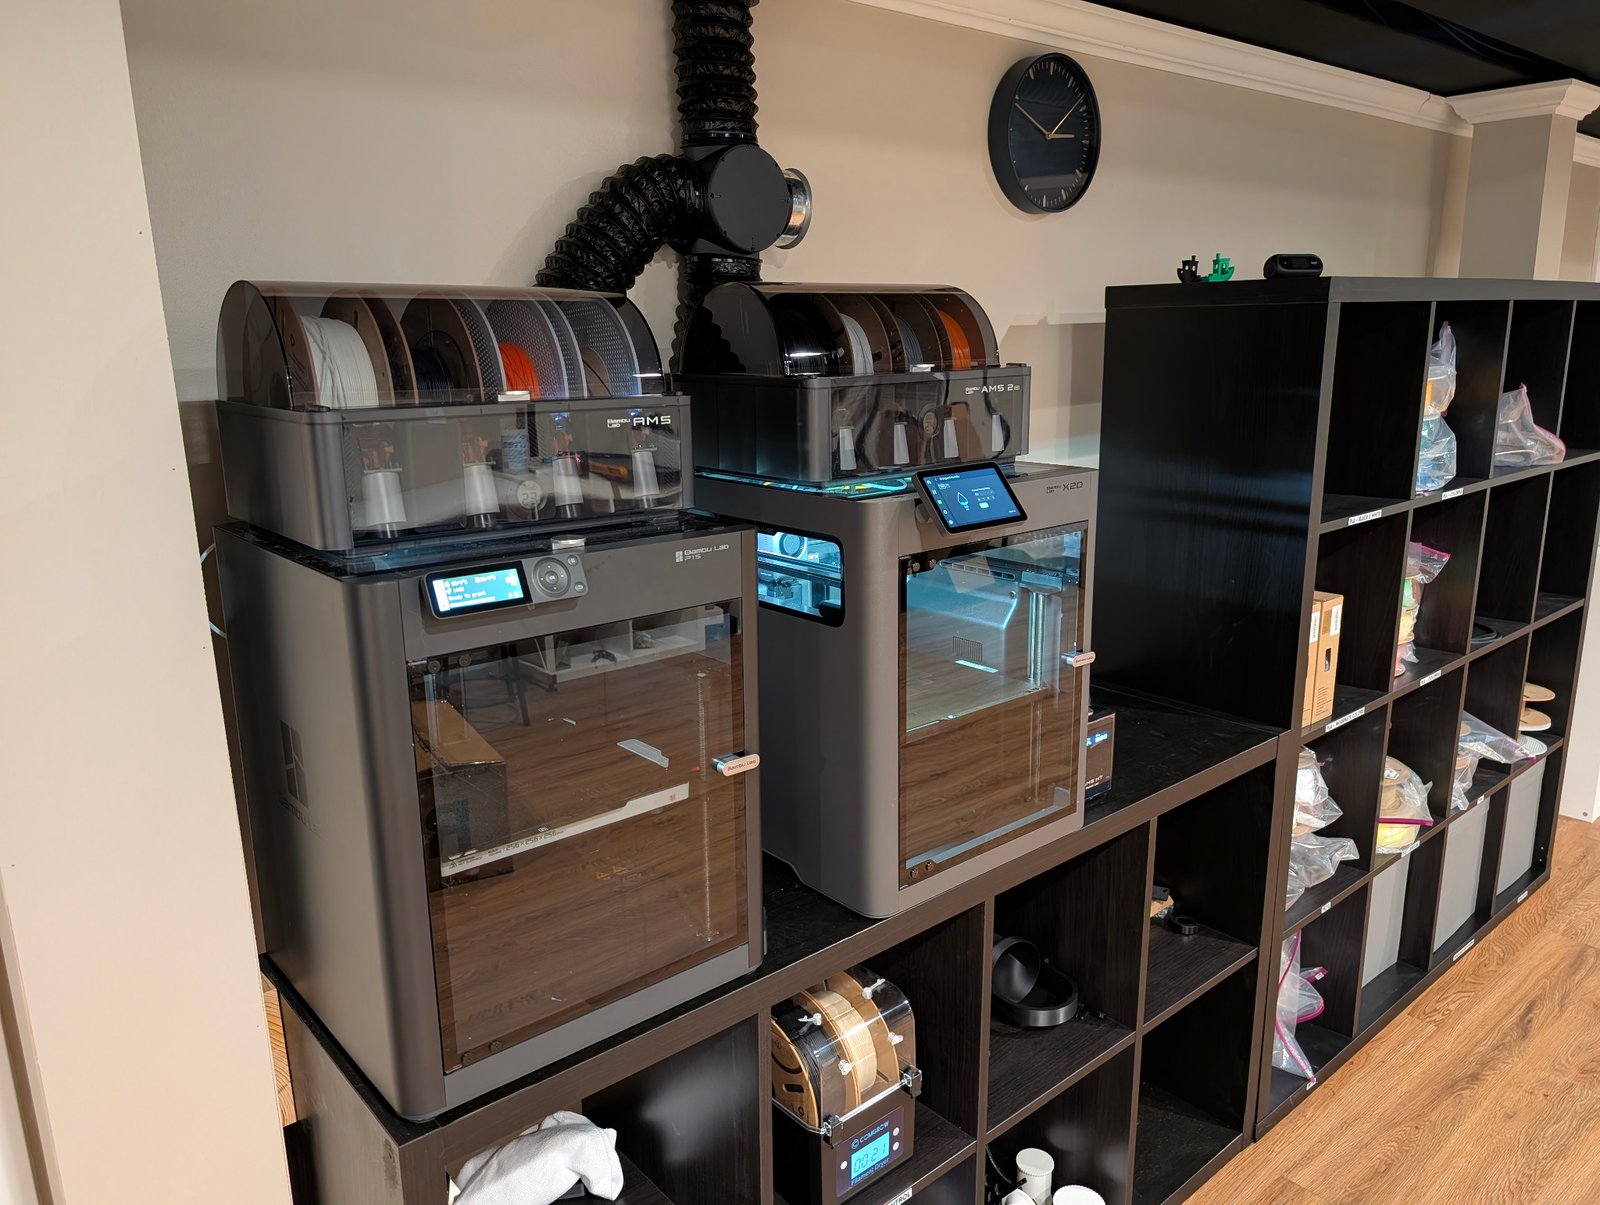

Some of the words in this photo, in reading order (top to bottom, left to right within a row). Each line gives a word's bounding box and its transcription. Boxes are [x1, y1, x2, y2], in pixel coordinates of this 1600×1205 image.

[633, 416, 671, 426] AMS
[1063, 481, 1083, 491] X2D
[728, 763, 745, 771] Bambu
[860, 1120, 889, 1143] COMGROW
[851, 1167, 874, 1186] Filament
[875, 1158, 889, 1169] Dryer
